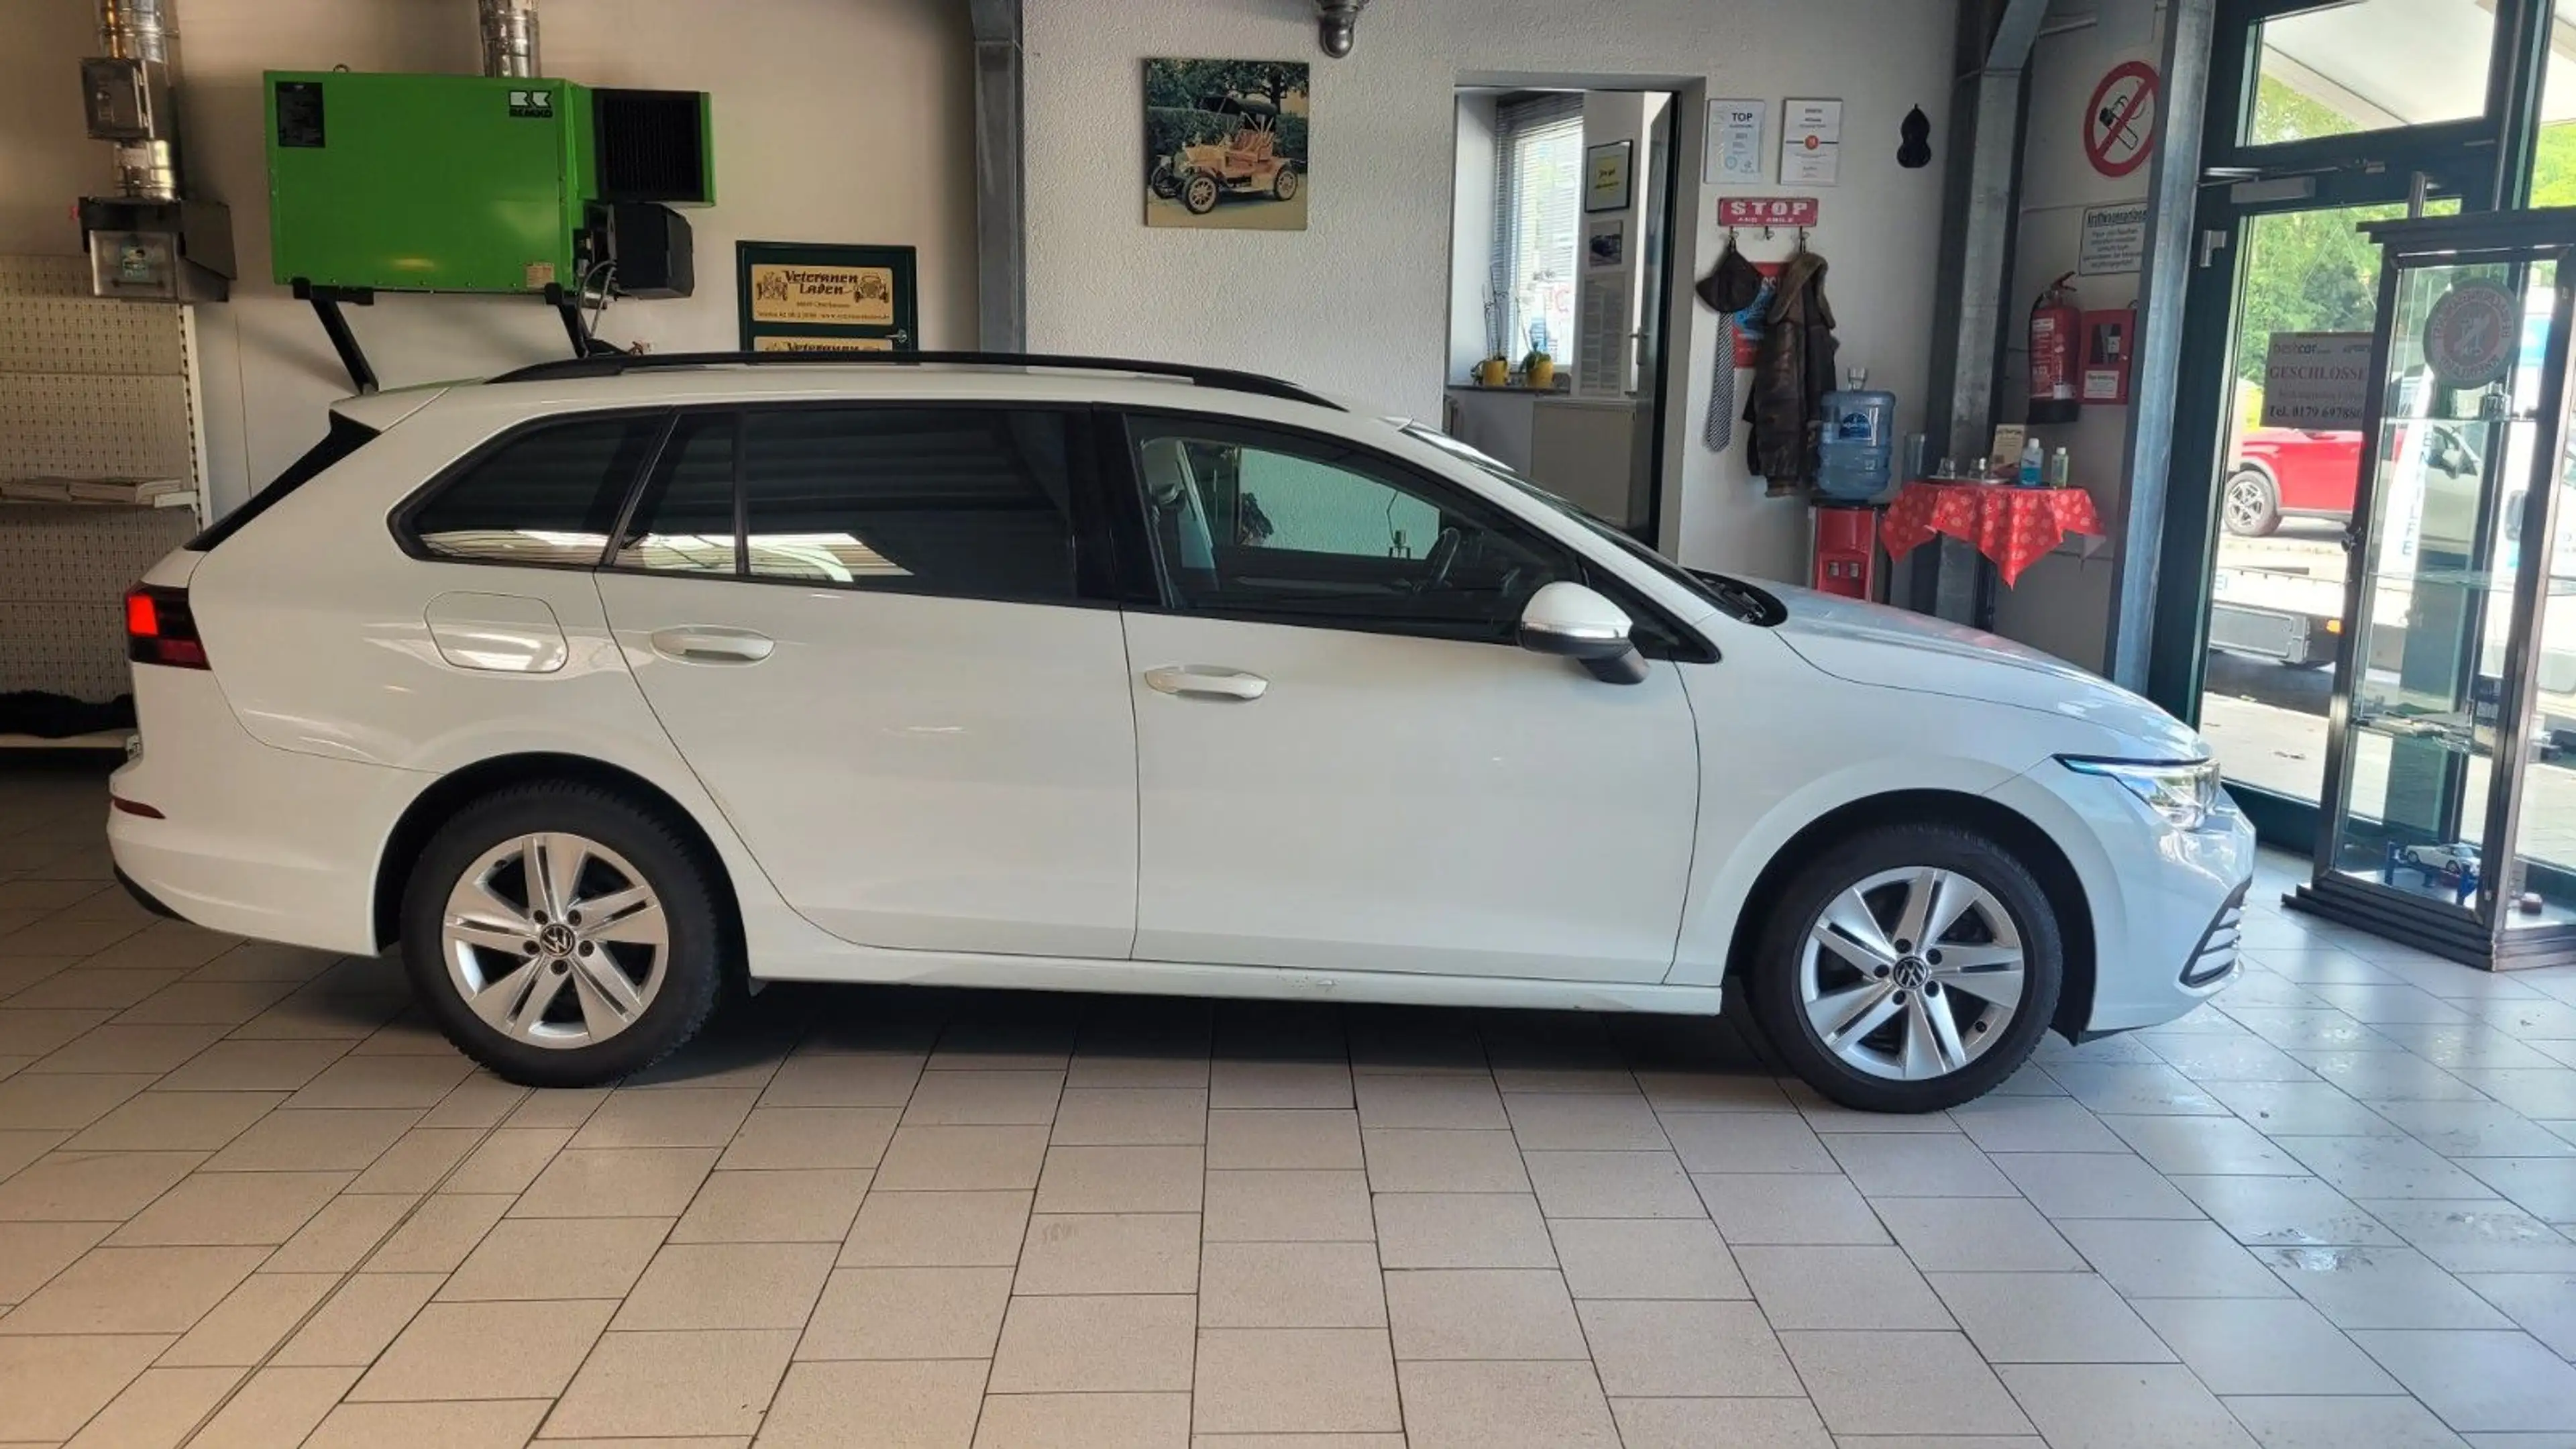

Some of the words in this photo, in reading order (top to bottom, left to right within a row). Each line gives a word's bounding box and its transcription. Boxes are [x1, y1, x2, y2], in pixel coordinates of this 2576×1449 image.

[1732, 113, 1753, 121] TOP
[1731, 202, 1807, 215] STOP
[782, 270, 858, 282] Veteranen
[800, 283, 843, 294] Laden
